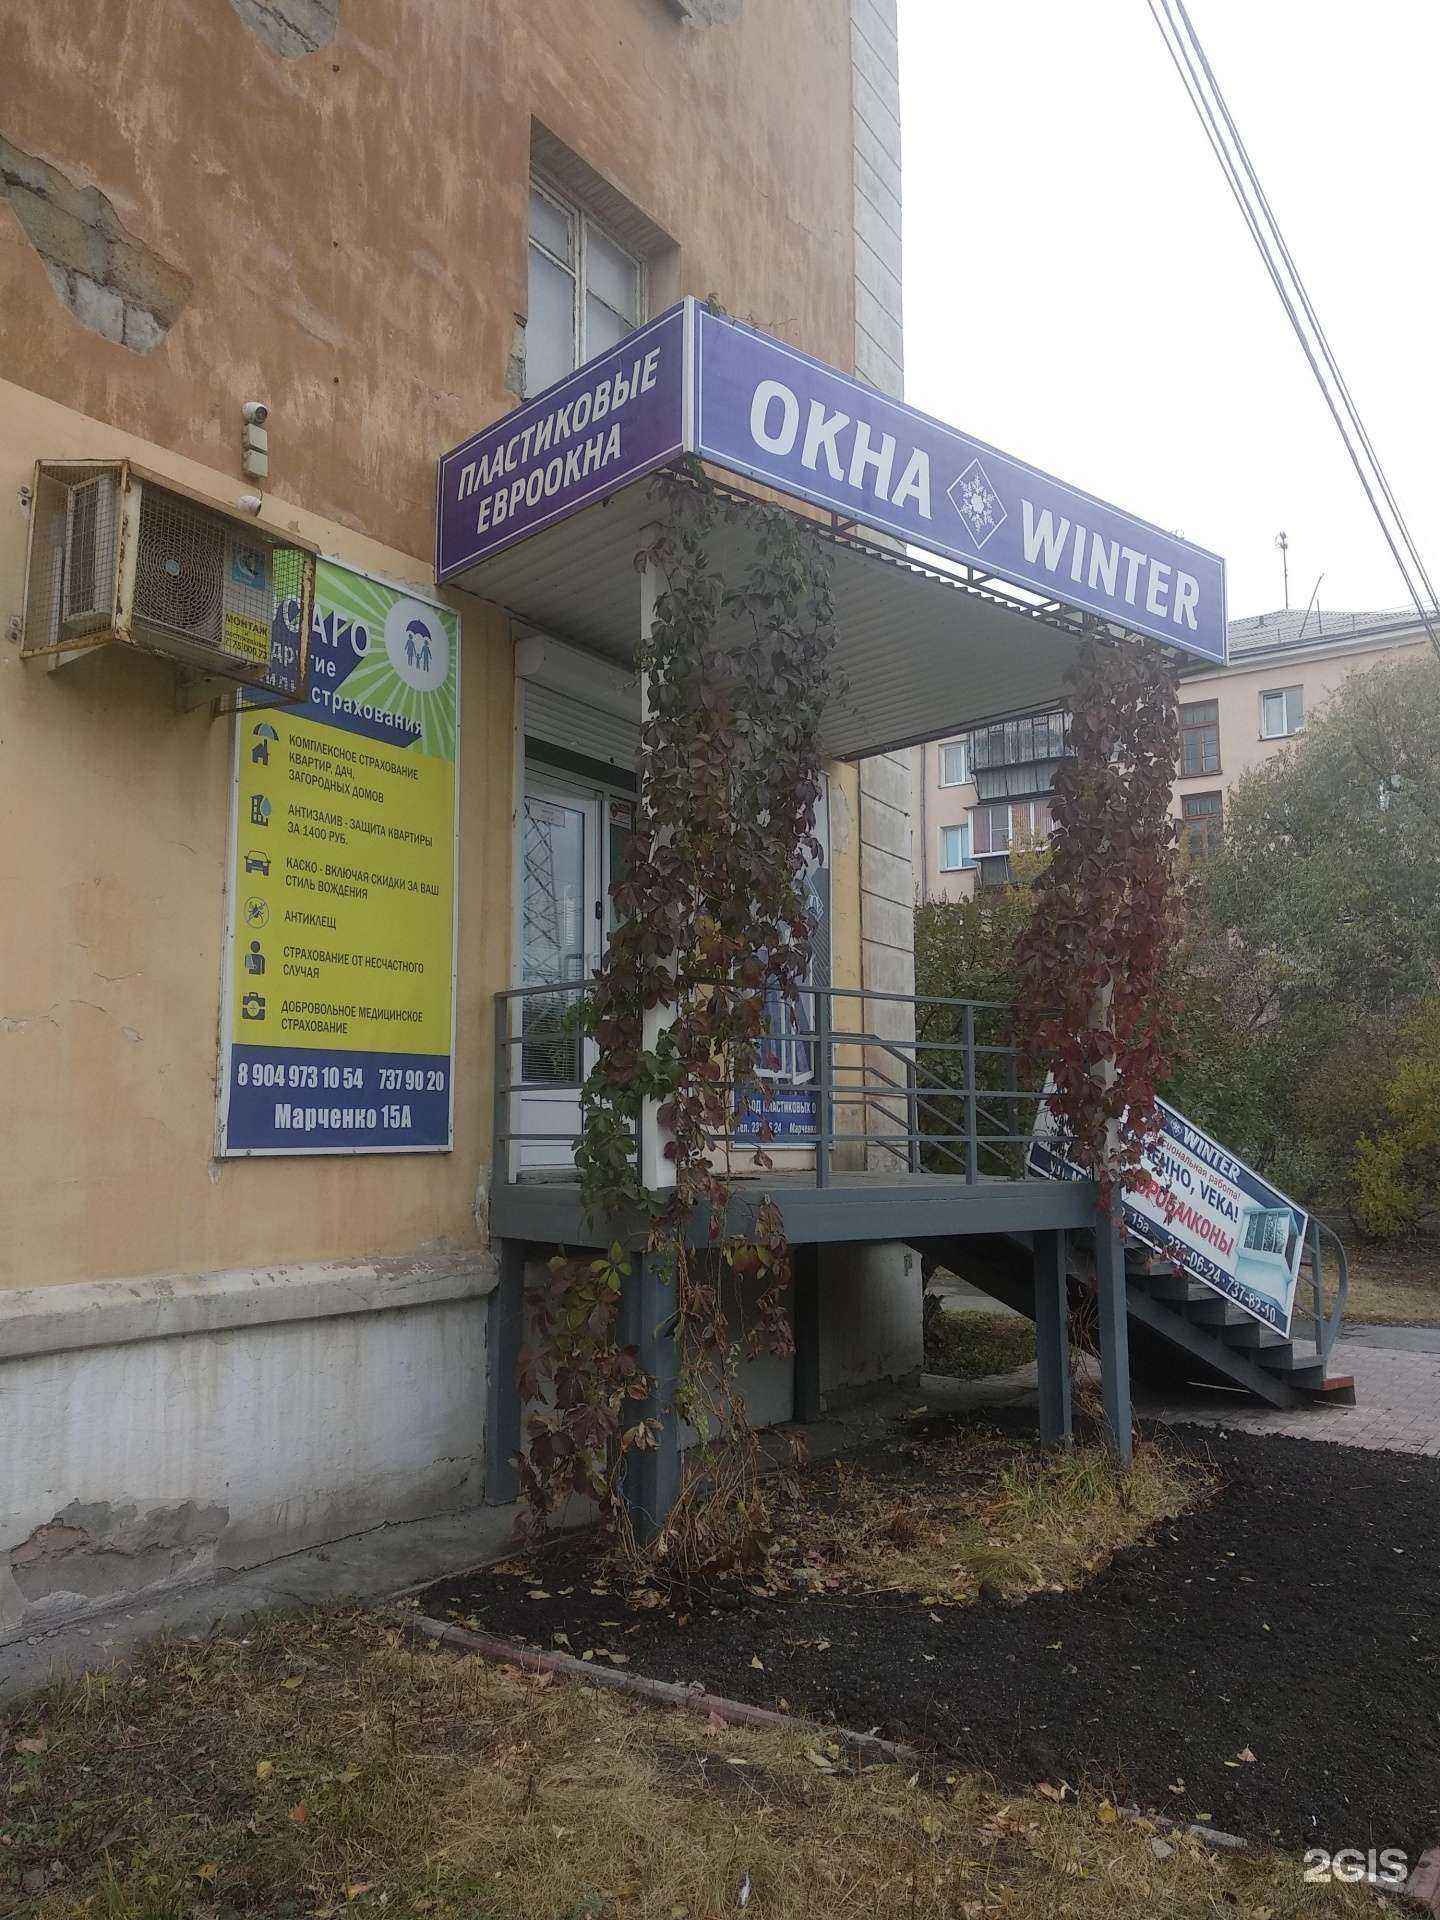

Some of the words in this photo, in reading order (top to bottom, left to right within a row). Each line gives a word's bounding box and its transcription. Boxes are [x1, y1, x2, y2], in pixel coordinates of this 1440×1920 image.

[457, 347, 661, 501] ПЛАСТИКОВЫЕ
[477, 422, 621, 534] ЕВРООКНА
[750, 379, 934, 519] ОКНА
[1020, 498, 1200, 630] WINTER
[311, 686, 422, 736] страхования
[288, 752, 333, 773] КВАРТИР,
[335, 763, 355, 780] ДАЧ,
[289, 734, 357, 763] КОМПЛЕКСНОЕ
[359, 754, 419, 780] СТРАХОВАНИЕ
[288, 769, 350, 794] ЗАГОРОДНЫХ
[352, 787, 384, 803] ДОМОВ
[288, 804, 343, 827] АНТИЗАЛИВ
[350, 818, 386, 837] ЗАЩИТА
[388, 827, 433, 847] КВАРТИРЫ
[288, 821, 300, 834] ЗА
[303, 826, 327, 841] 1400
[329, 831, 349, 845] РУБ.
[285, 875, 315, 891] СТИЛЬ
[317, 881, 368, 900] ВОЖДЕНИЯ
[286, 857, 317, 874] КАСКО
[325, 864, 369, 882] ВКЛЮЧАЯ
[371, 873, 405, 889] СКИДКИ
[407, 878, 418, 891] ЗА
[420, 880, 439, 896] ВАШ
[284, 910, 337, 931] АНТИКЛЕЩ
[283, 946, 349, 963] СТРАХОВАНИЕ
[351, 954, 362, 965] ОТ
[364, 956, 424, 974] НЕСЧАСТНОГО
[283, 964, 320, 979] СЛУЧАЯ
[281, 1000, 356, 1018] ДОБРОВОЛЬНОЕ
[358, 1006, 423, 1023] МЕДИЦИНСКОЕ
[281, 1018, 348, 1034] СТРАХОВАНИЕ
[238, 1063, 248, 1086] 8
[252, 1064, 285, 1087] 904
[289, 1065, 317, 1088] 973
[321, 1066, 339, 1088] 10
[343, 1067, 363, 1089] 54
[379, 1069, 402, 1090] 737
[405, 1070, 424, 1091] 90
[426, 1070, 444, 1091] 20
[274, 1103, 376, 1131] Марченко
[381, 1104, 412, 1128] 15А
[789, 1122, 816, 1136] Марченк
[1182, 1127, 1240, 1184] WINTER
[1208, 1174, 1241, 1201] работа!
[1225, 1276, 1276, 1323] 737-82-10
